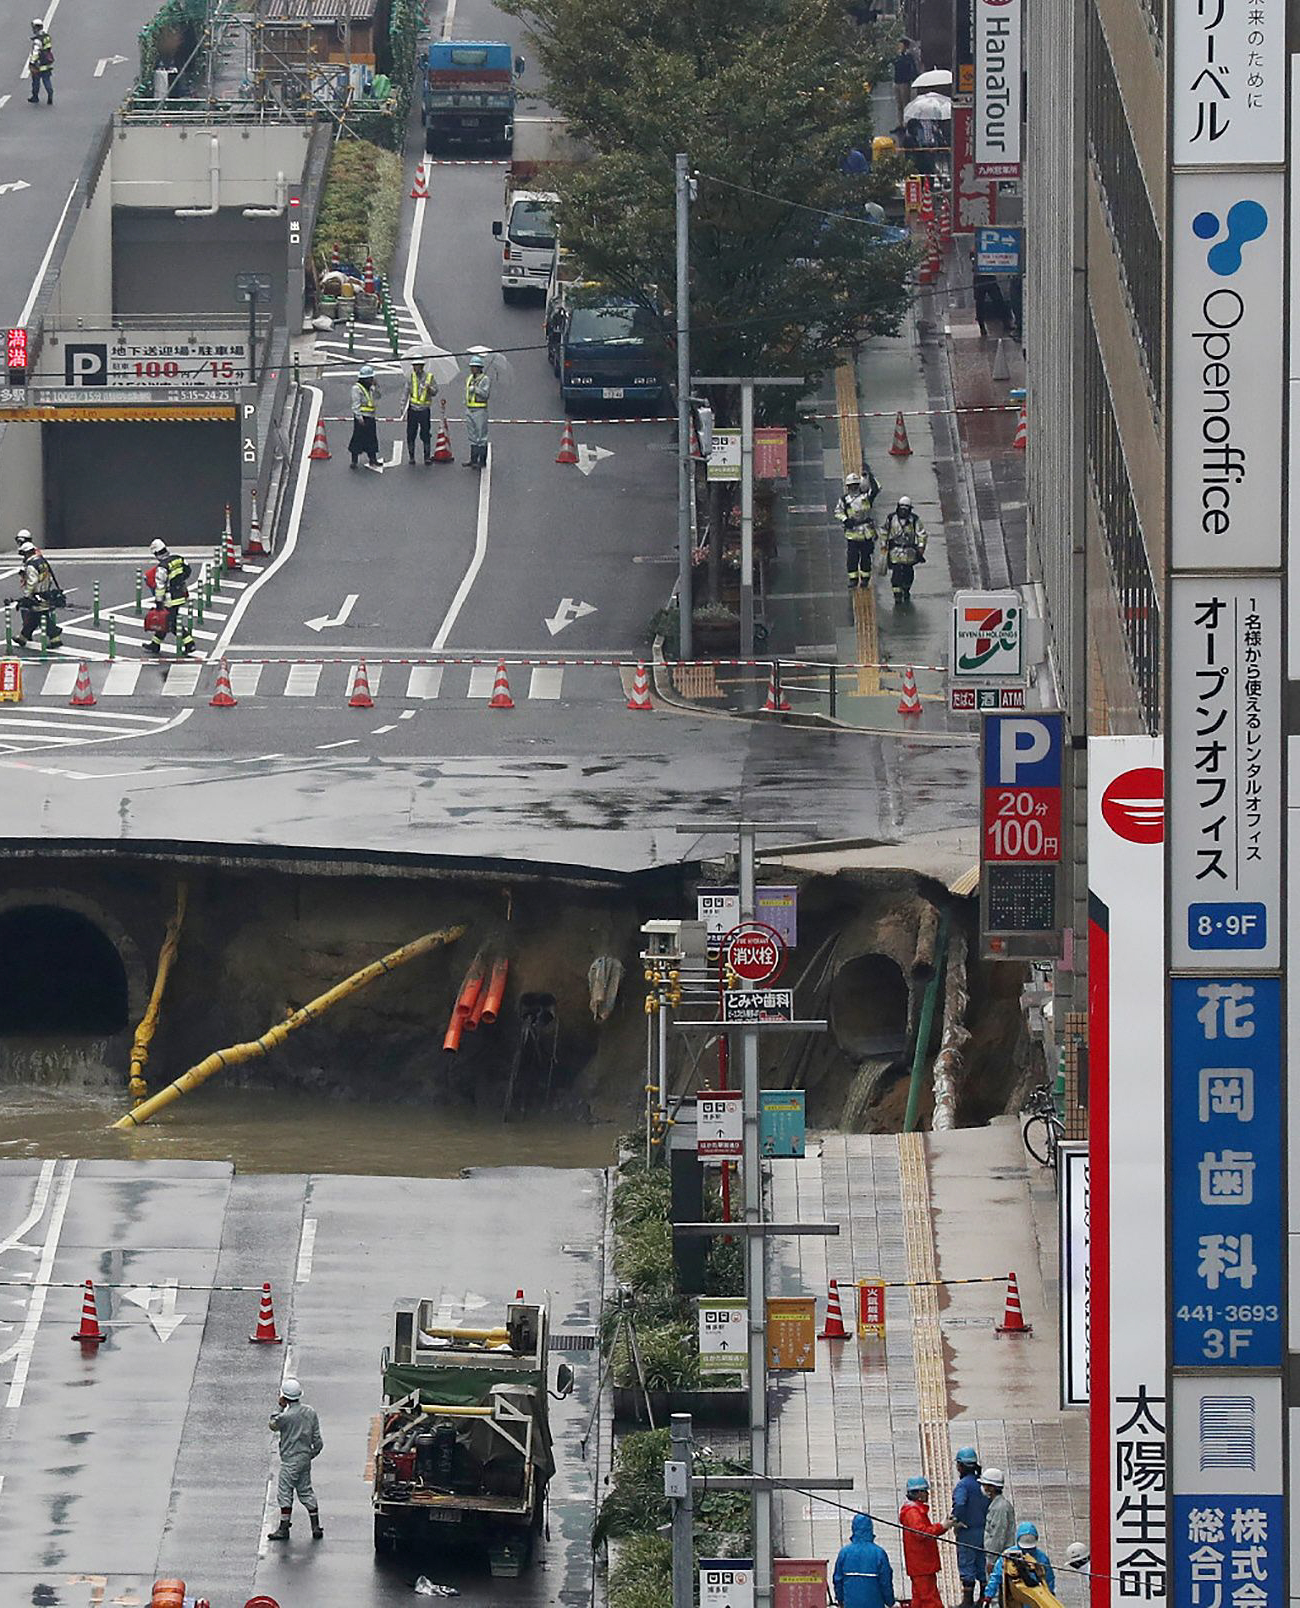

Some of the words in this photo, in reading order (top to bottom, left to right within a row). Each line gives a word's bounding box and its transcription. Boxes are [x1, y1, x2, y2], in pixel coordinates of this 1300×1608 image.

[1248, 0, 1265, 109] 来のために
[985, 17, 1010, 152] HanaTour
[981, 231, 1000, 251] P
[73, 352, 102, 385] P
[244, 405, 255, 419] P
[1191, 289, 1246, 535] Openoffice
[244, 439, 256, 462] 入口
[981, 691, 996, 707] 酒
[1003, 692, 1023, 707] ATM
[1194, 597, 1230, 880] オープンオフィス
[1244, 598, 1263, 861] 1名様から使えるレンタルオフィス
[1000, 719, 1051, 784] P
[998, 792, 1049, 817] 20分
[988, 819, 1058, 856] 100円
[733, 947, 774, 966] 消火栓
[728, 993, 790, 1008] とみや歯科
[1197, 983, 1257, 1290] 花岡歯科
[1176, 1305, 1279, 1323] 441-3693
[1202, 1328, 1254, 1359] 3F
[1116, 1384, 1166, 1600] 太陽生命
